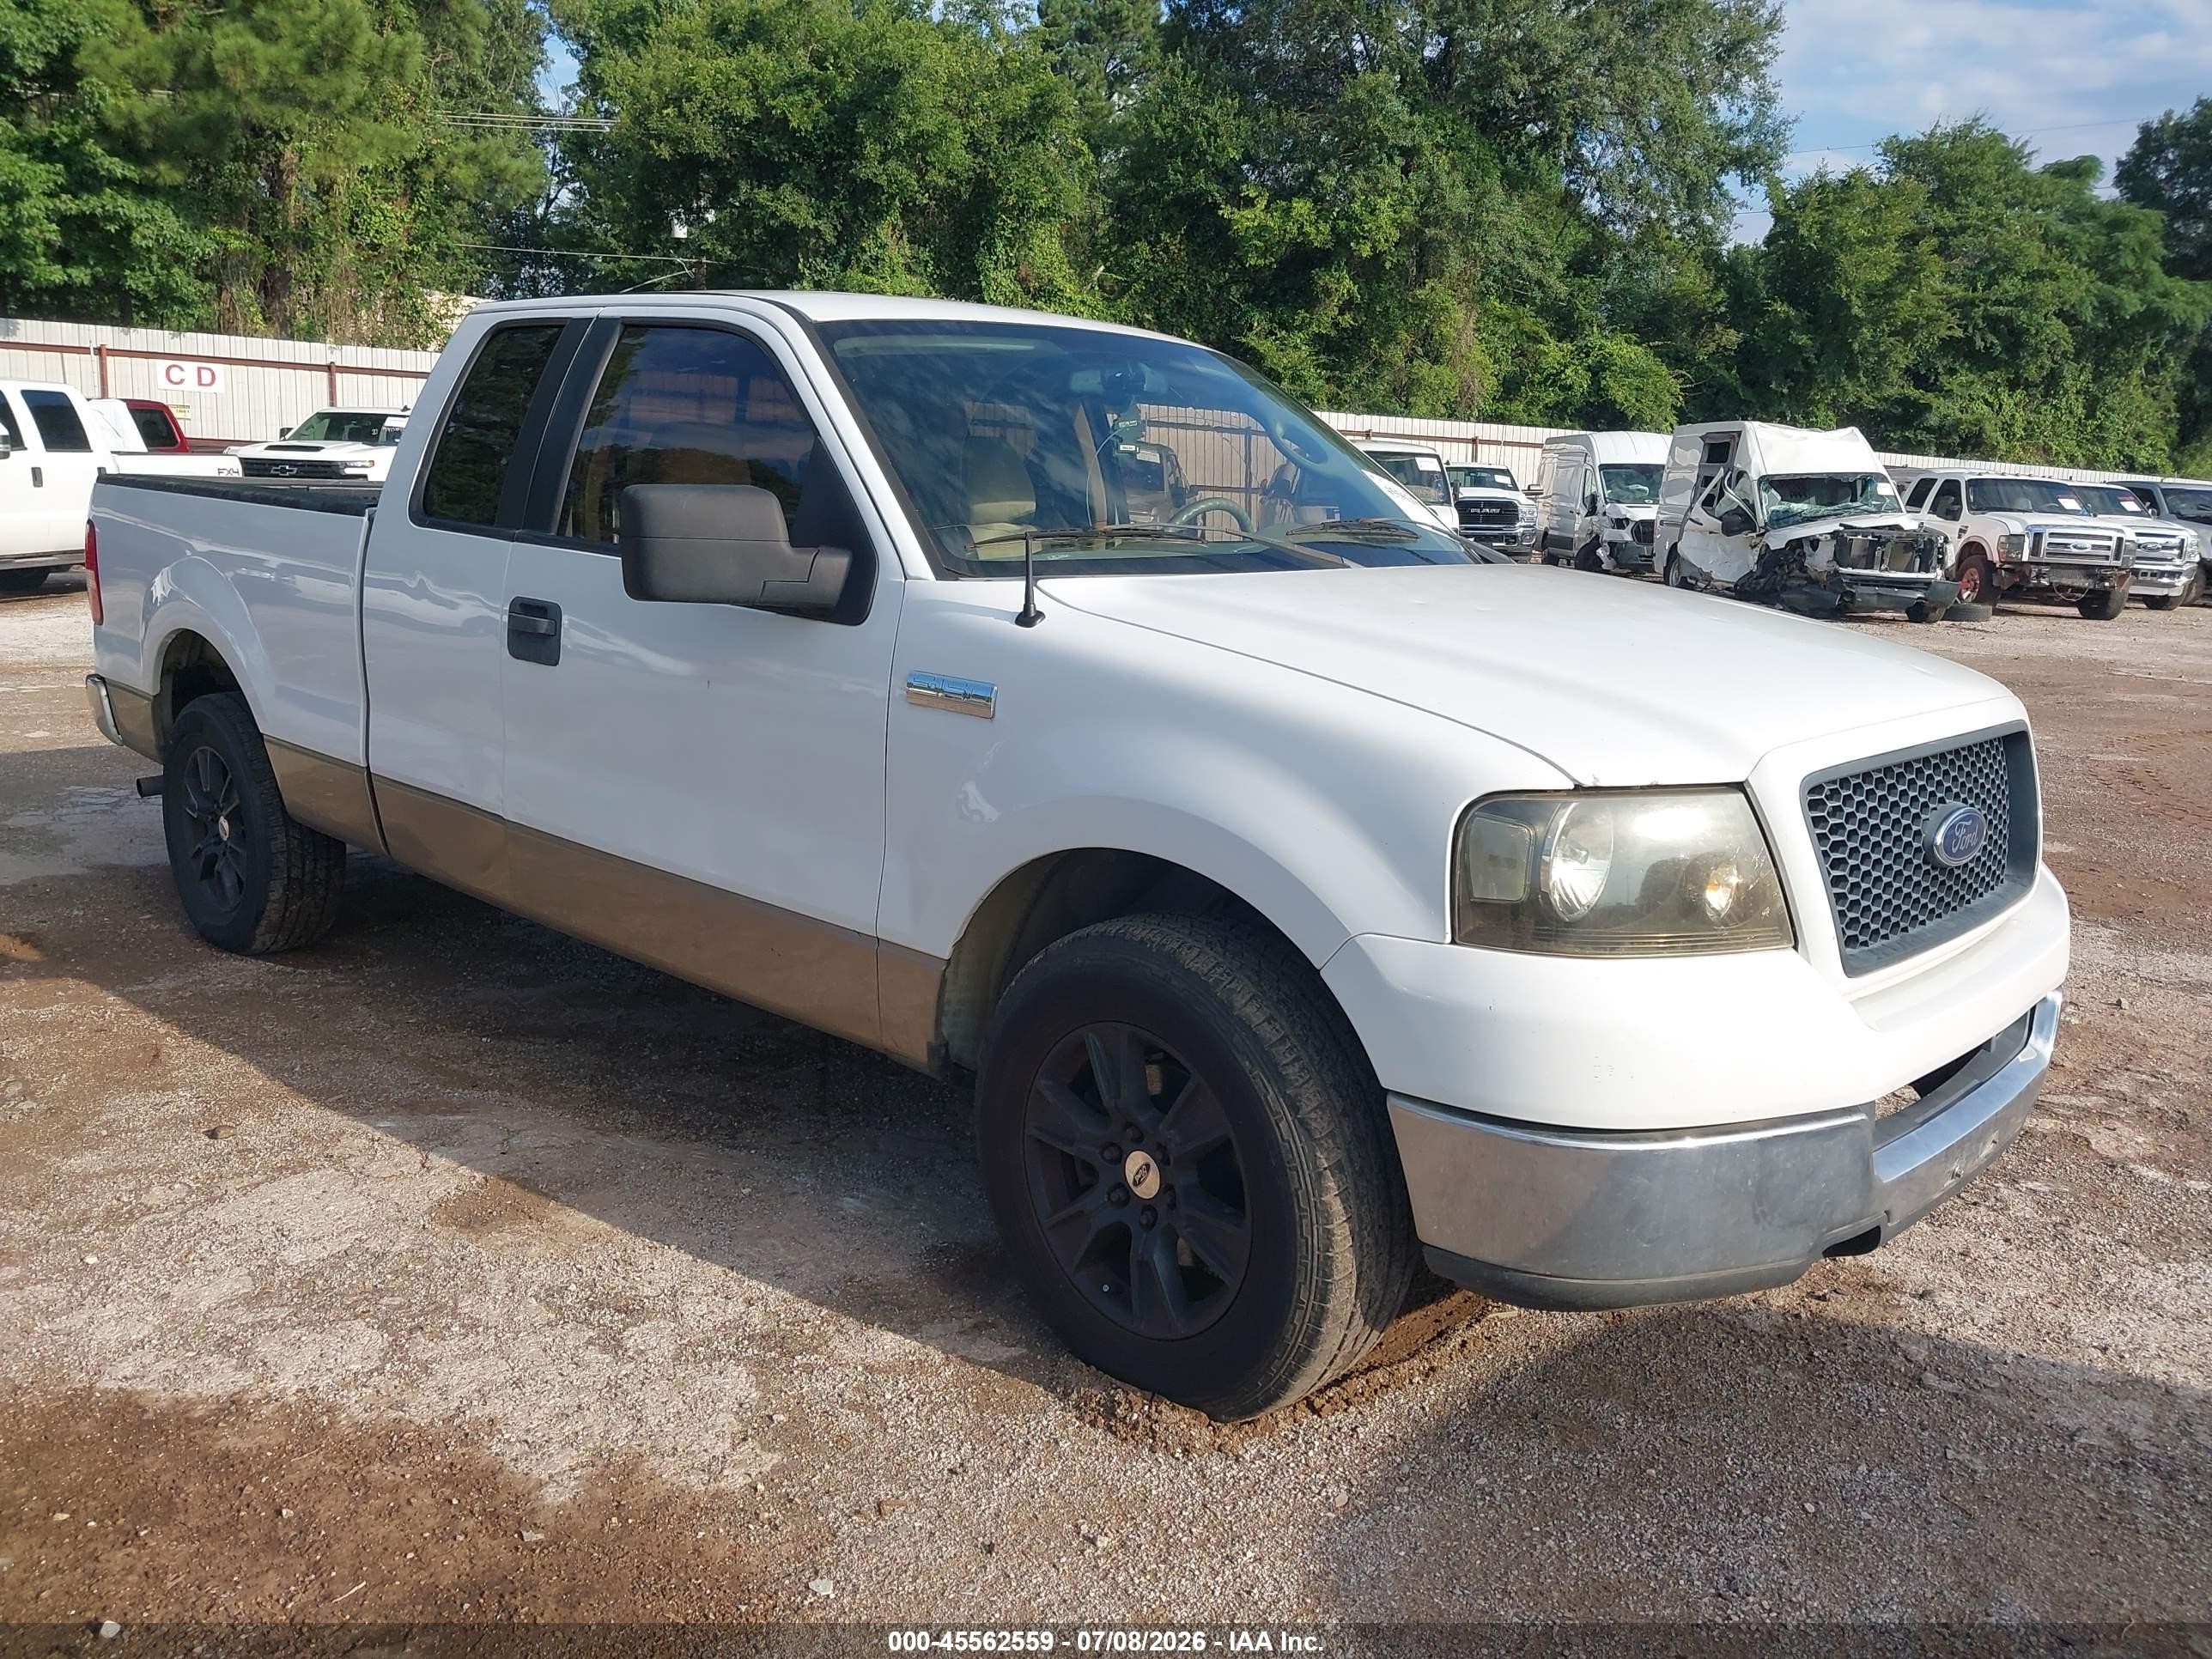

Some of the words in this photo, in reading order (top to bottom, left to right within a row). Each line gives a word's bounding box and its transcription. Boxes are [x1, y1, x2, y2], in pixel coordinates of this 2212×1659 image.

[166, 364, 185, 385] C
[197, 367, 216, 386] D
[1952, 819, 1978, 854] Ford
